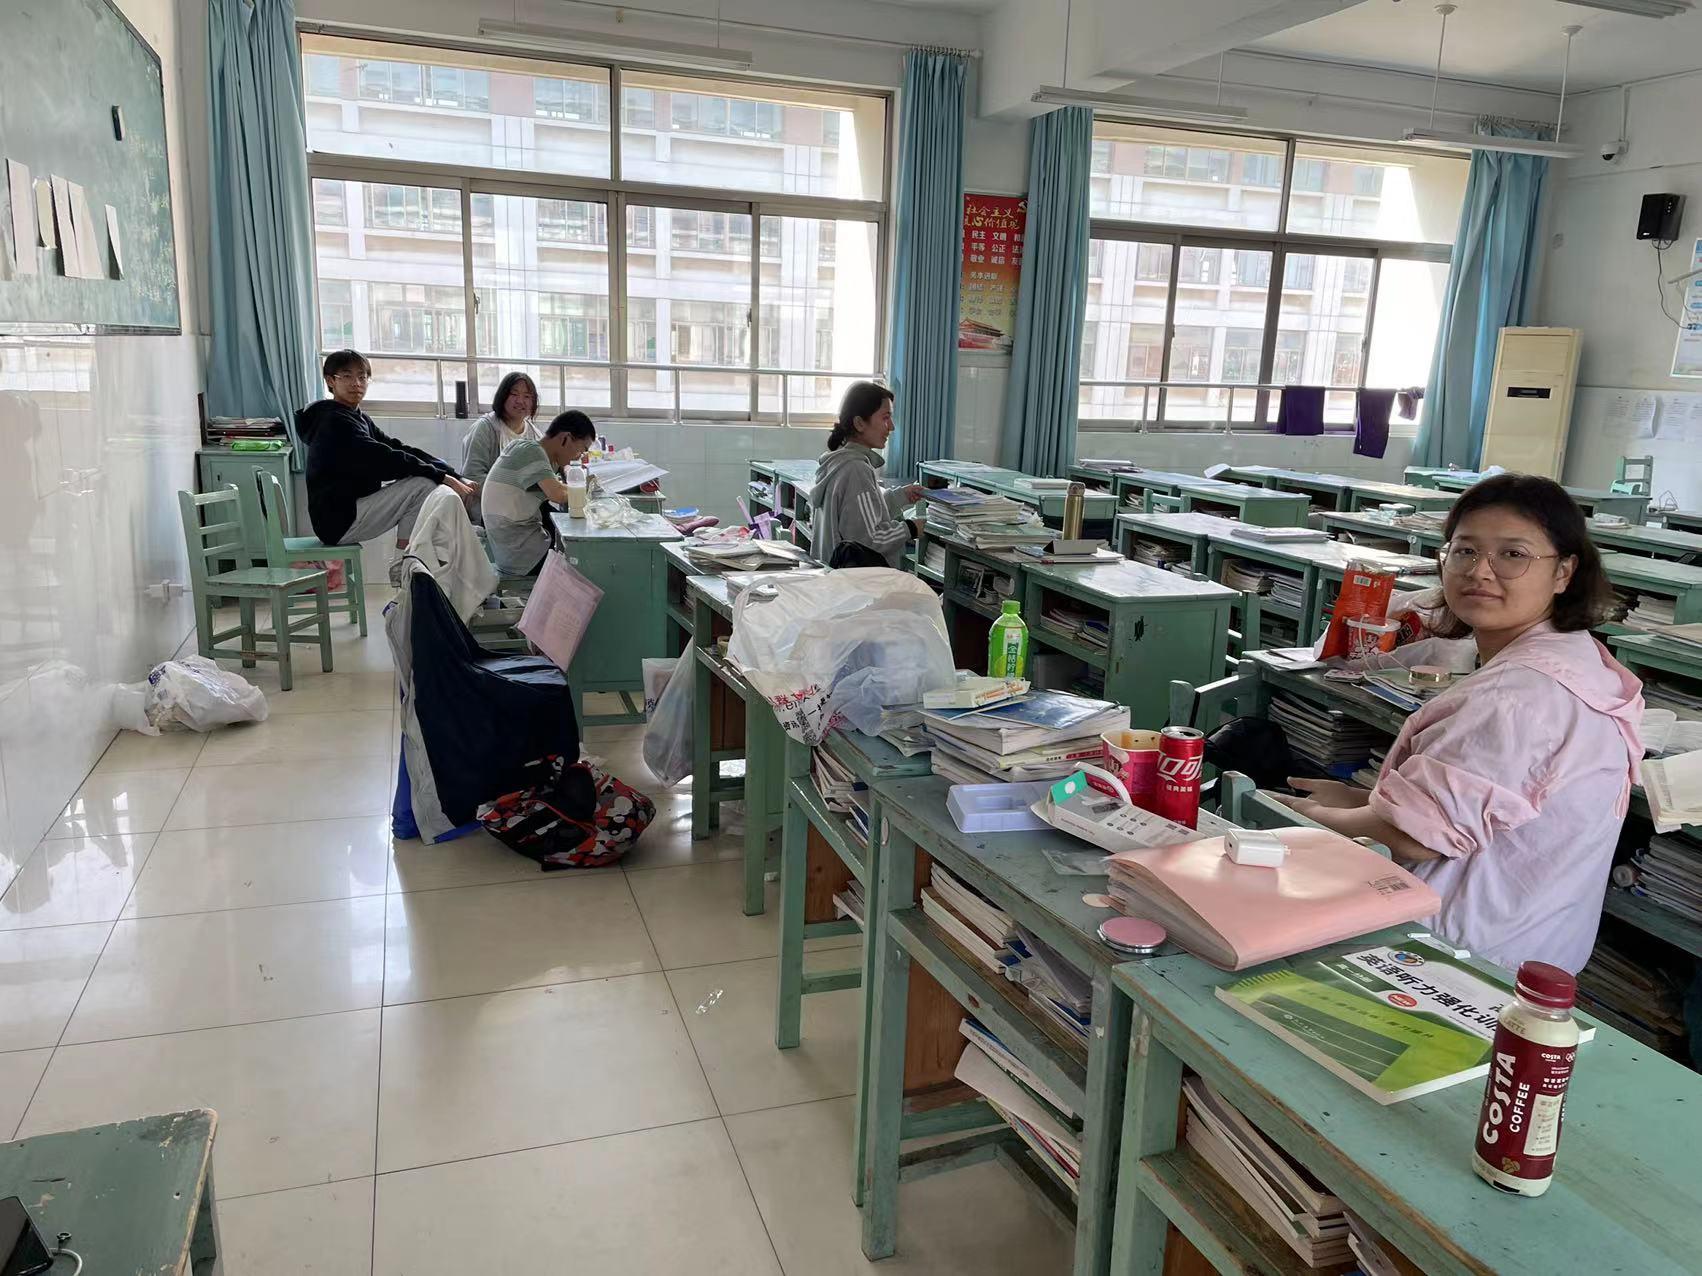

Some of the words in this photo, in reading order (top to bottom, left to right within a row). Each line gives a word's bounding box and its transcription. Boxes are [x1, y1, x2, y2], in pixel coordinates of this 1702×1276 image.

[966, 205, 1014, 218] 社会主义
[971, 230, 986, 240] 民主
[993, 232, 1007, 241] 文明
[971, 243, 985, 252] 平等
[992, 244, 1006, 253] 公正
[991, 256, 1005, 265] 诚信
[1356, 953, 1498, 1032] 英语听力强化训
[1541, 1052, 1561, 1061] COSTA
[1482, 1052, 1517, 1145] COSTA
[1509, 1082, 1531, 1133] COFFEE
